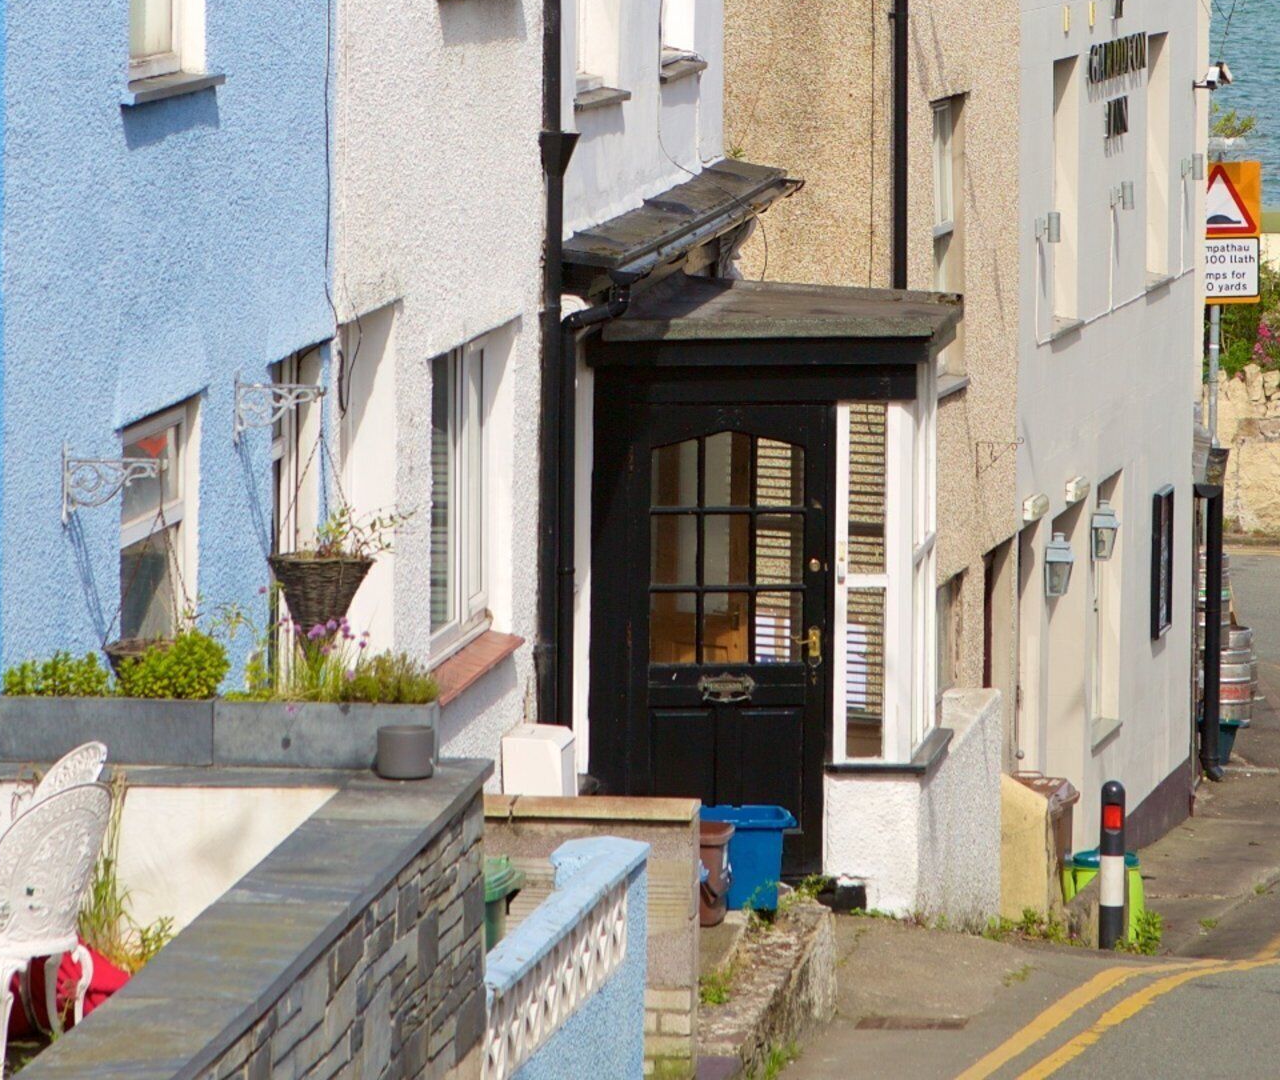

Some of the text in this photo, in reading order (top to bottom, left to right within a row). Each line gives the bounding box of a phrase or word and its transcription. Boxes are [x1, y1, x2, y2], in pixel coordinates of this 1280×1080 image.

[1206, 243, 1250, 253] mpathau
[1230, 254, 1255, 263] llath
[1206, 270, 1246, 280] mps for
[1218, 281, 1248, 292] yards
